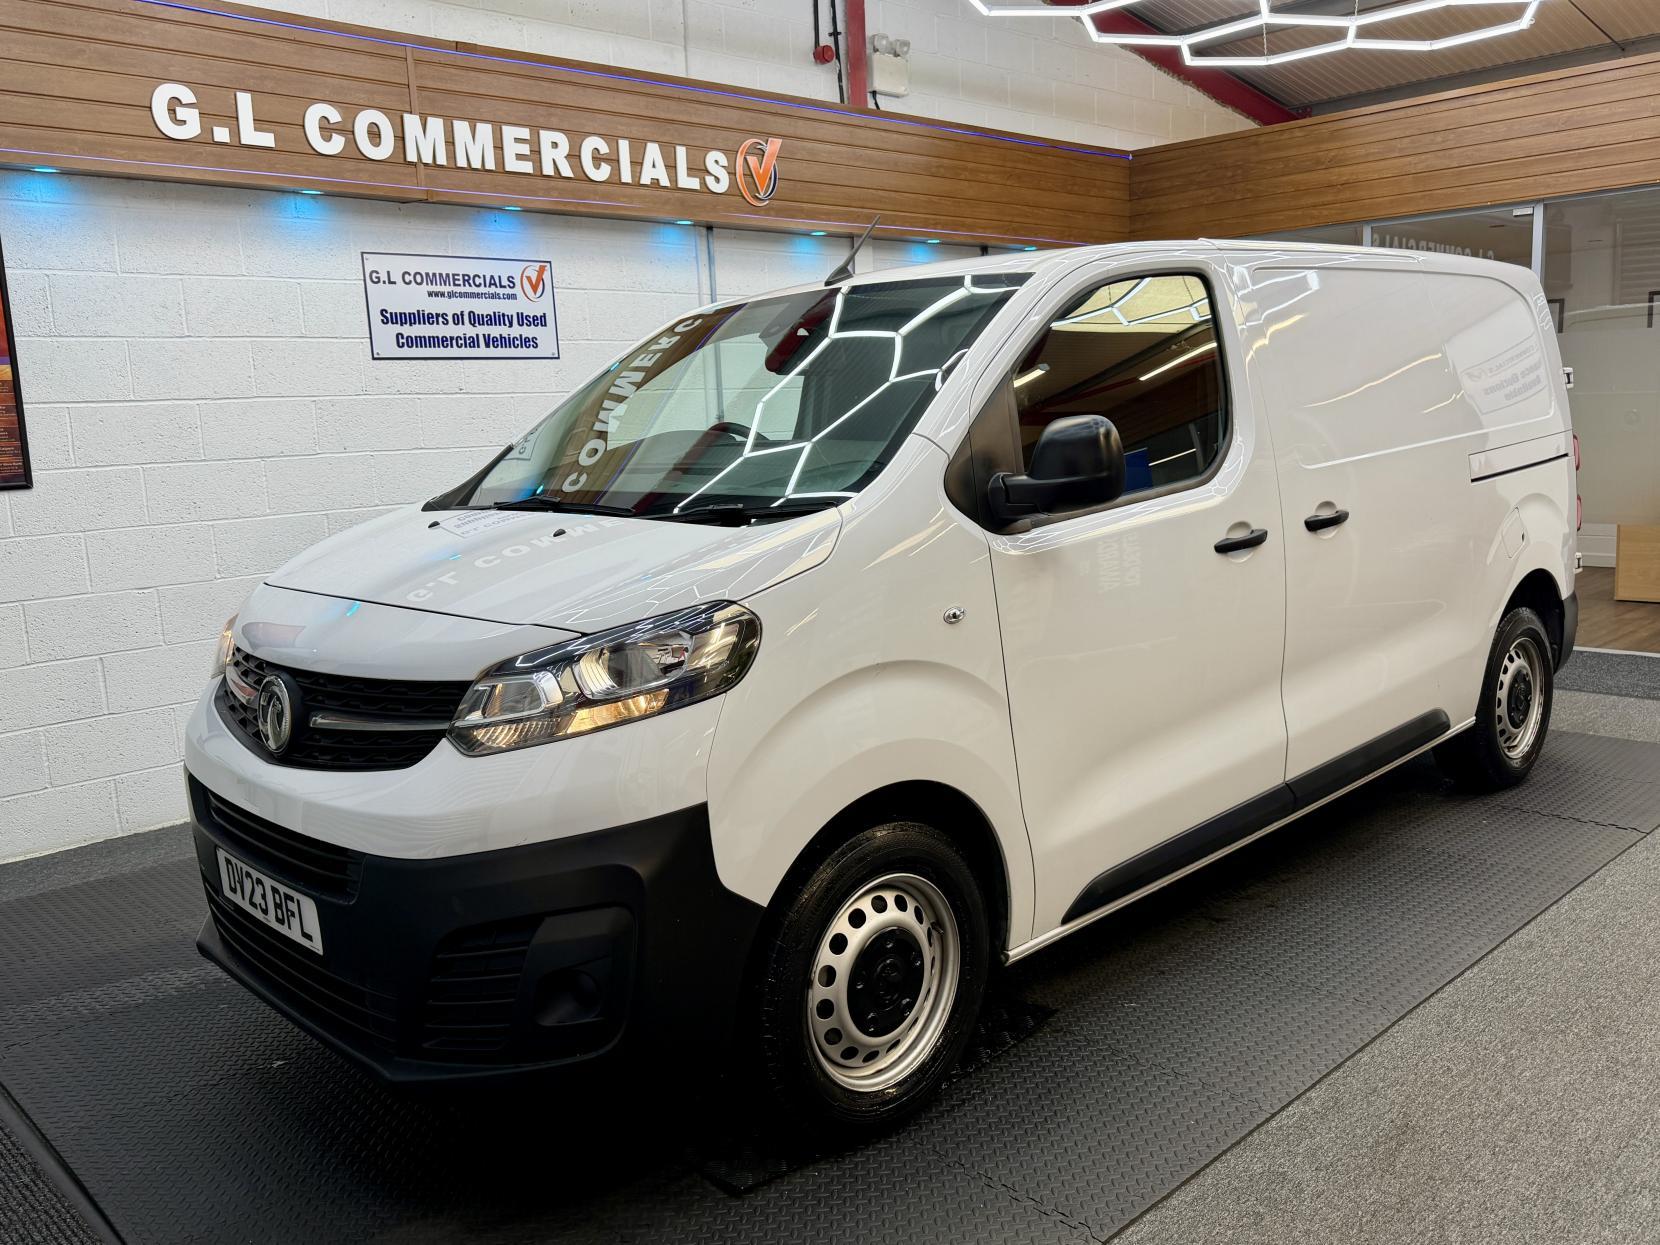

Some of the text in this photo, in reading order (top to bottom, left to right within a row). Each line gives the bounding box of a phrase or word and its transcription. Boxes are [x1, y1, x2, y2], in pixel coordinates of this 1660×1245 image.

[151, 83, 731, 194] G.L COMMERCIALS
[368, 269, 516, 289] G.L COMMERCIALS
[427, 289, 518, 301] www.glcommercials.com
[379, 308, 547, 328] Suppliers of Quality Used
[395, 332, 539, 349] Commercial Vehicles
[224, 856, 314, 943] DV23 BFL
